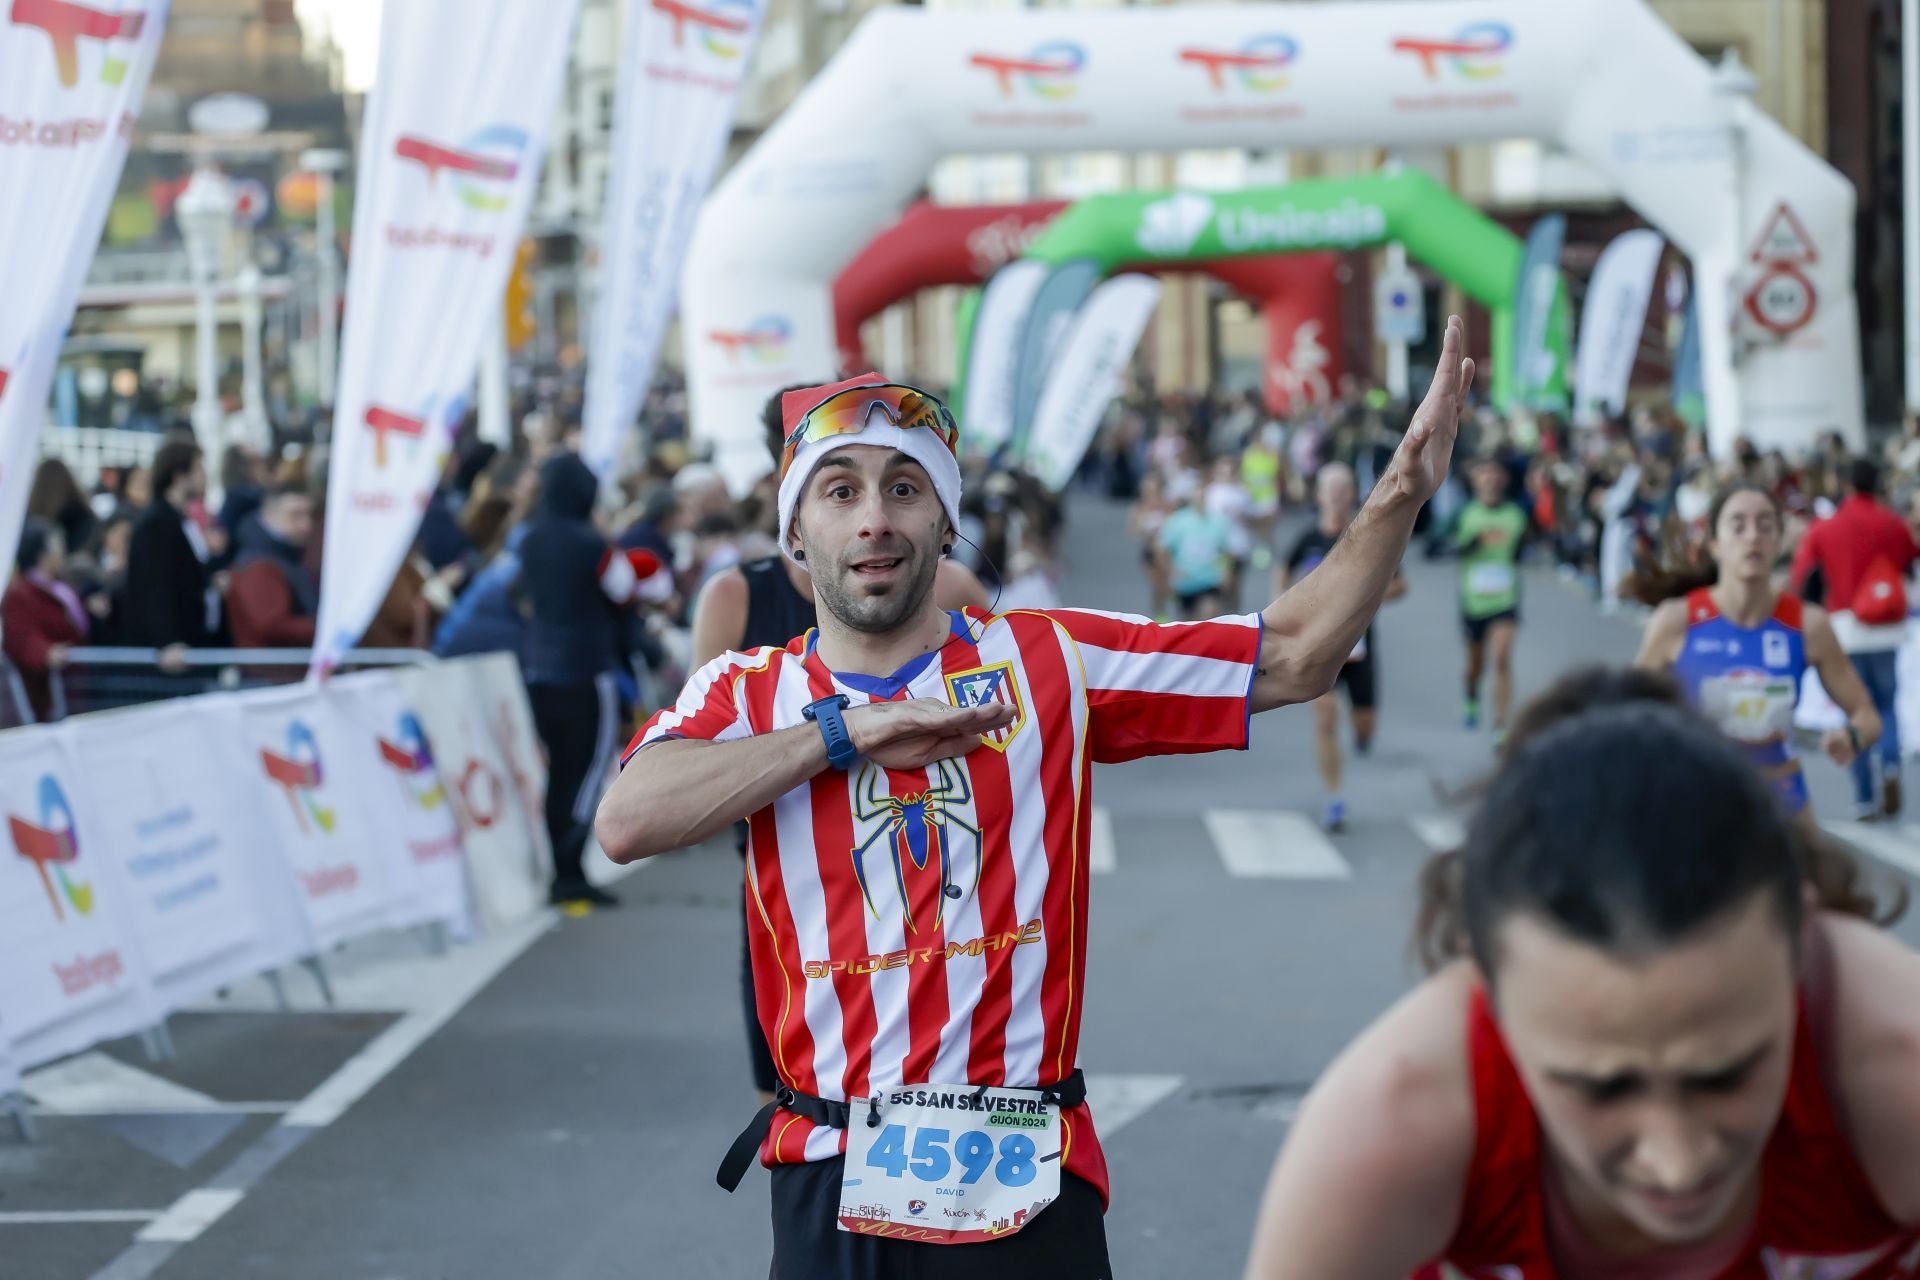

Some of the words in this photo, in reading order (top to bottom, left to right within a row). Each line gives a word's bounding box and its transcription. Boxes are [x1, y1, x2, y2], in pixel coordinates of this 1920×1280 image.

[1217, 199, 1386, 251] Unicaja
[889, 1091, 914, 1106] 55
[915, 1090, 955, 1110] SAN
[956, 1093, 1048, 1115] SLVESTRE
[989, 1113, 1021, 1127] GIJÓN
[1021, 1116, 1047, 1128] 2024
[865, 1123, 1038, 1188] 4598
[935, 1187, 965, 1197] DAVID
